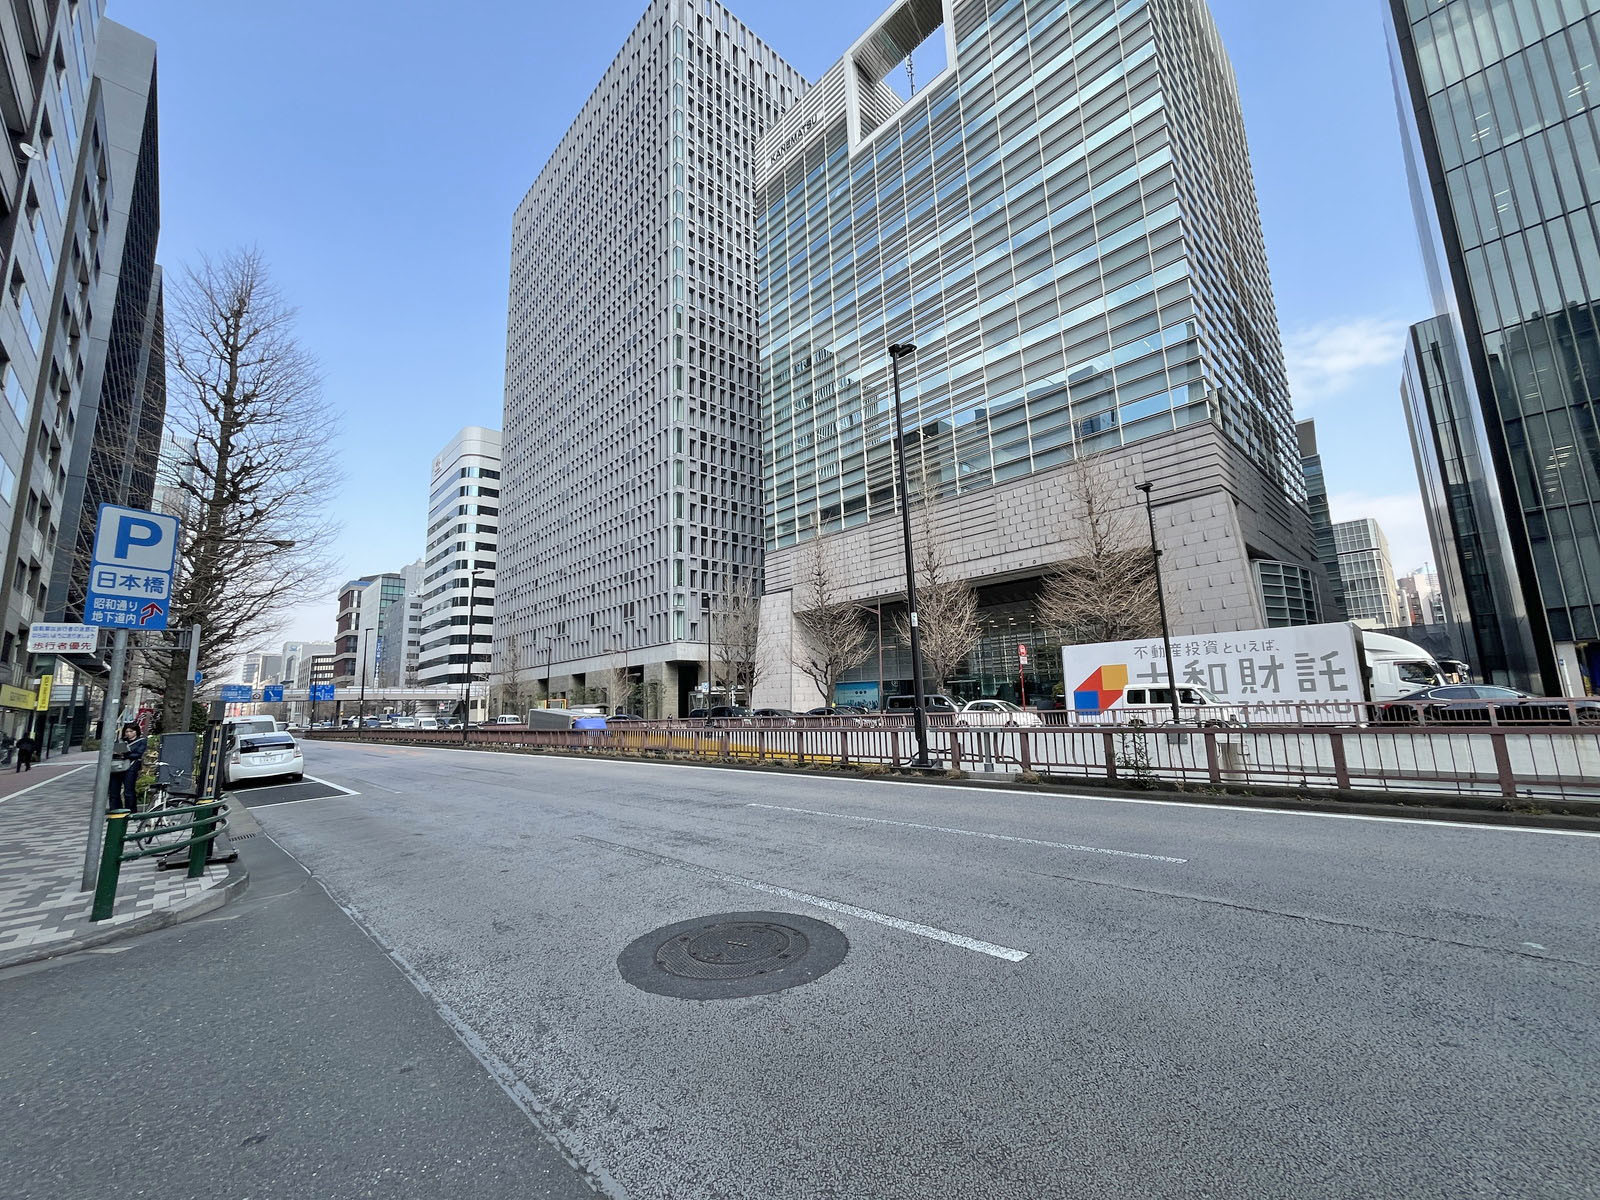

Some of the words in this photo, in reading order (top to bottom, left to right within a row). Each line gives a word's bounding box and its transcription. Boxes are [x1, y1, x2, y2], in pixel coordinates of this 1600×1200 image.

[770, 114, 818, 164] KANEMATSU
[114, 515, 163, 559] P
[97, 571, 165, 594] 日本橋
[93, 597, 138, 612] 昭和通り
[91, 611, 136, 625] 地下道内
[32, 641, 92, 651] 歩行者優先
